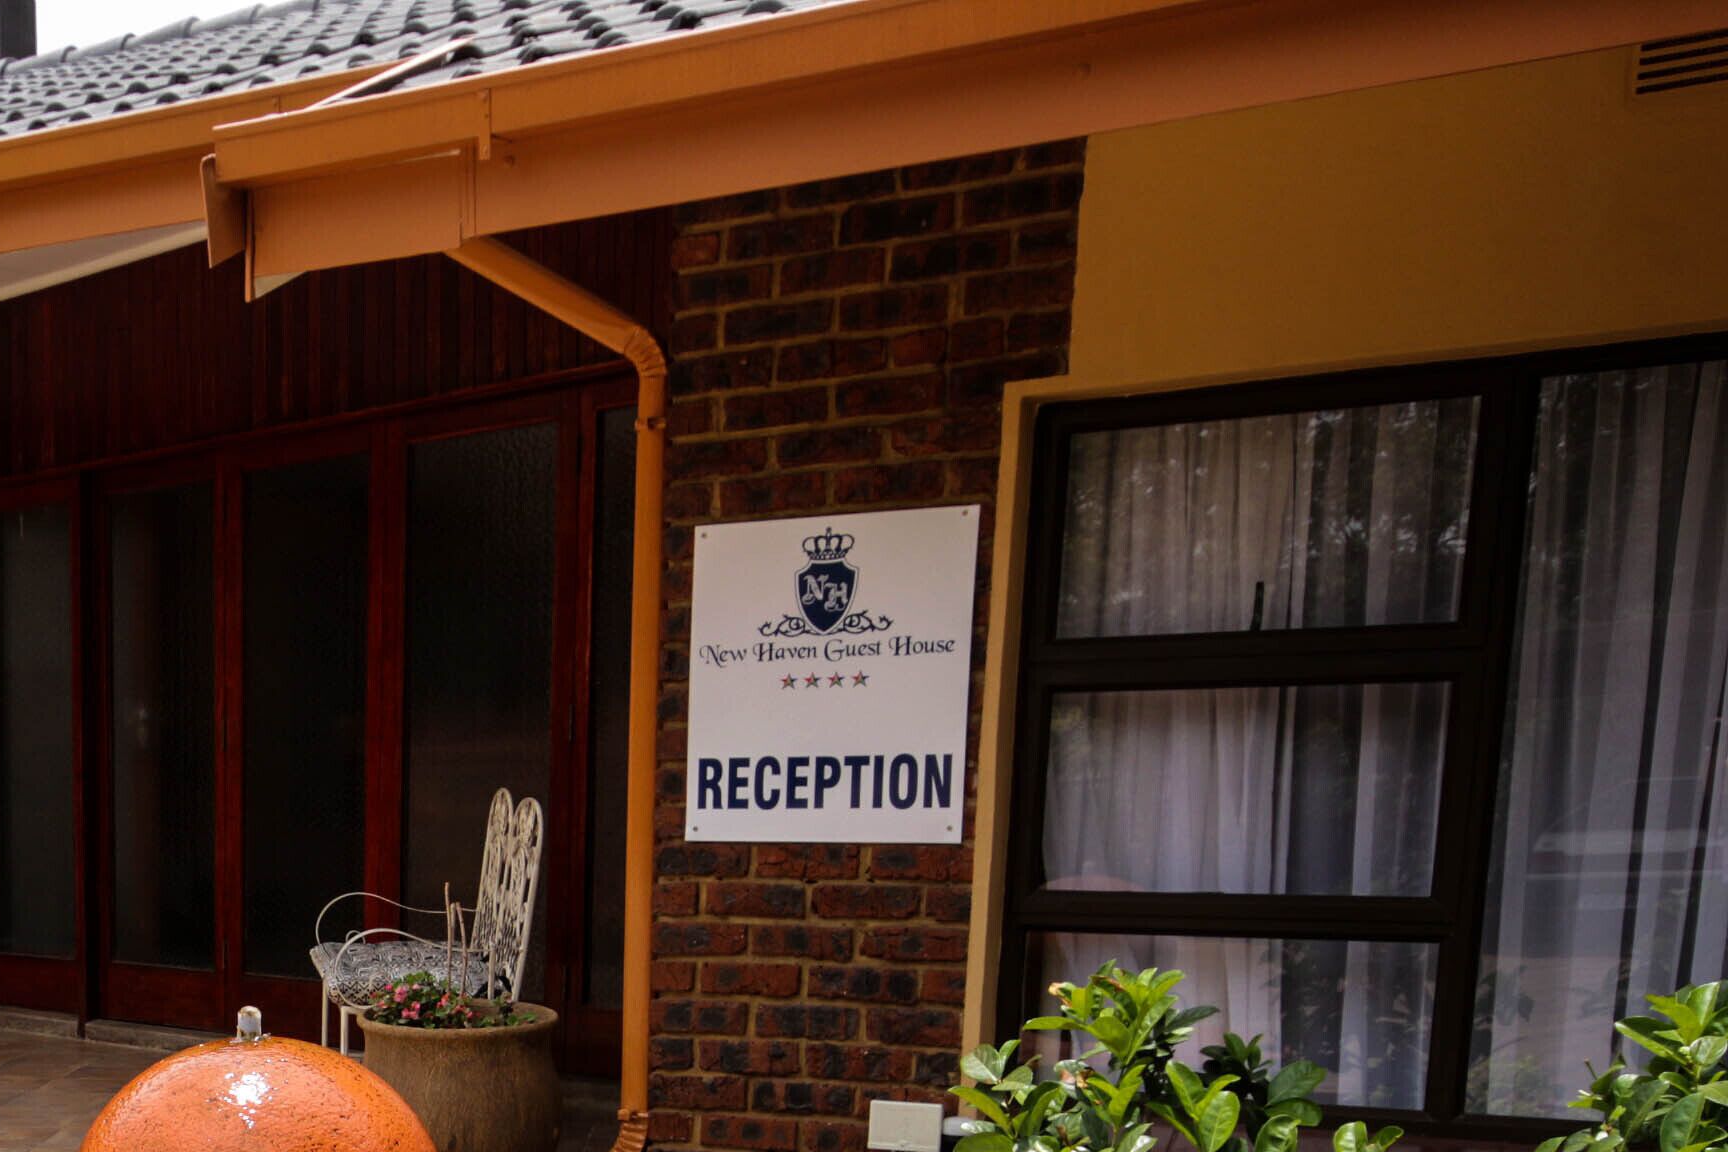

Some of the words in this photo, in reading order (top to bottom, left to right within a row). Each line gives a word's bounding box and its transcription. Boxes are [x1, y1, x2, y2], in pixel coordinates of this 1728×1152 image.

[699, 643, 748, 668] New
[753, 642, 817, 664] Haven
[824, 638, 881, 661] Guest
[889, 636, 955, 656] House
[697, 753, 953, 810] RECEPTION
